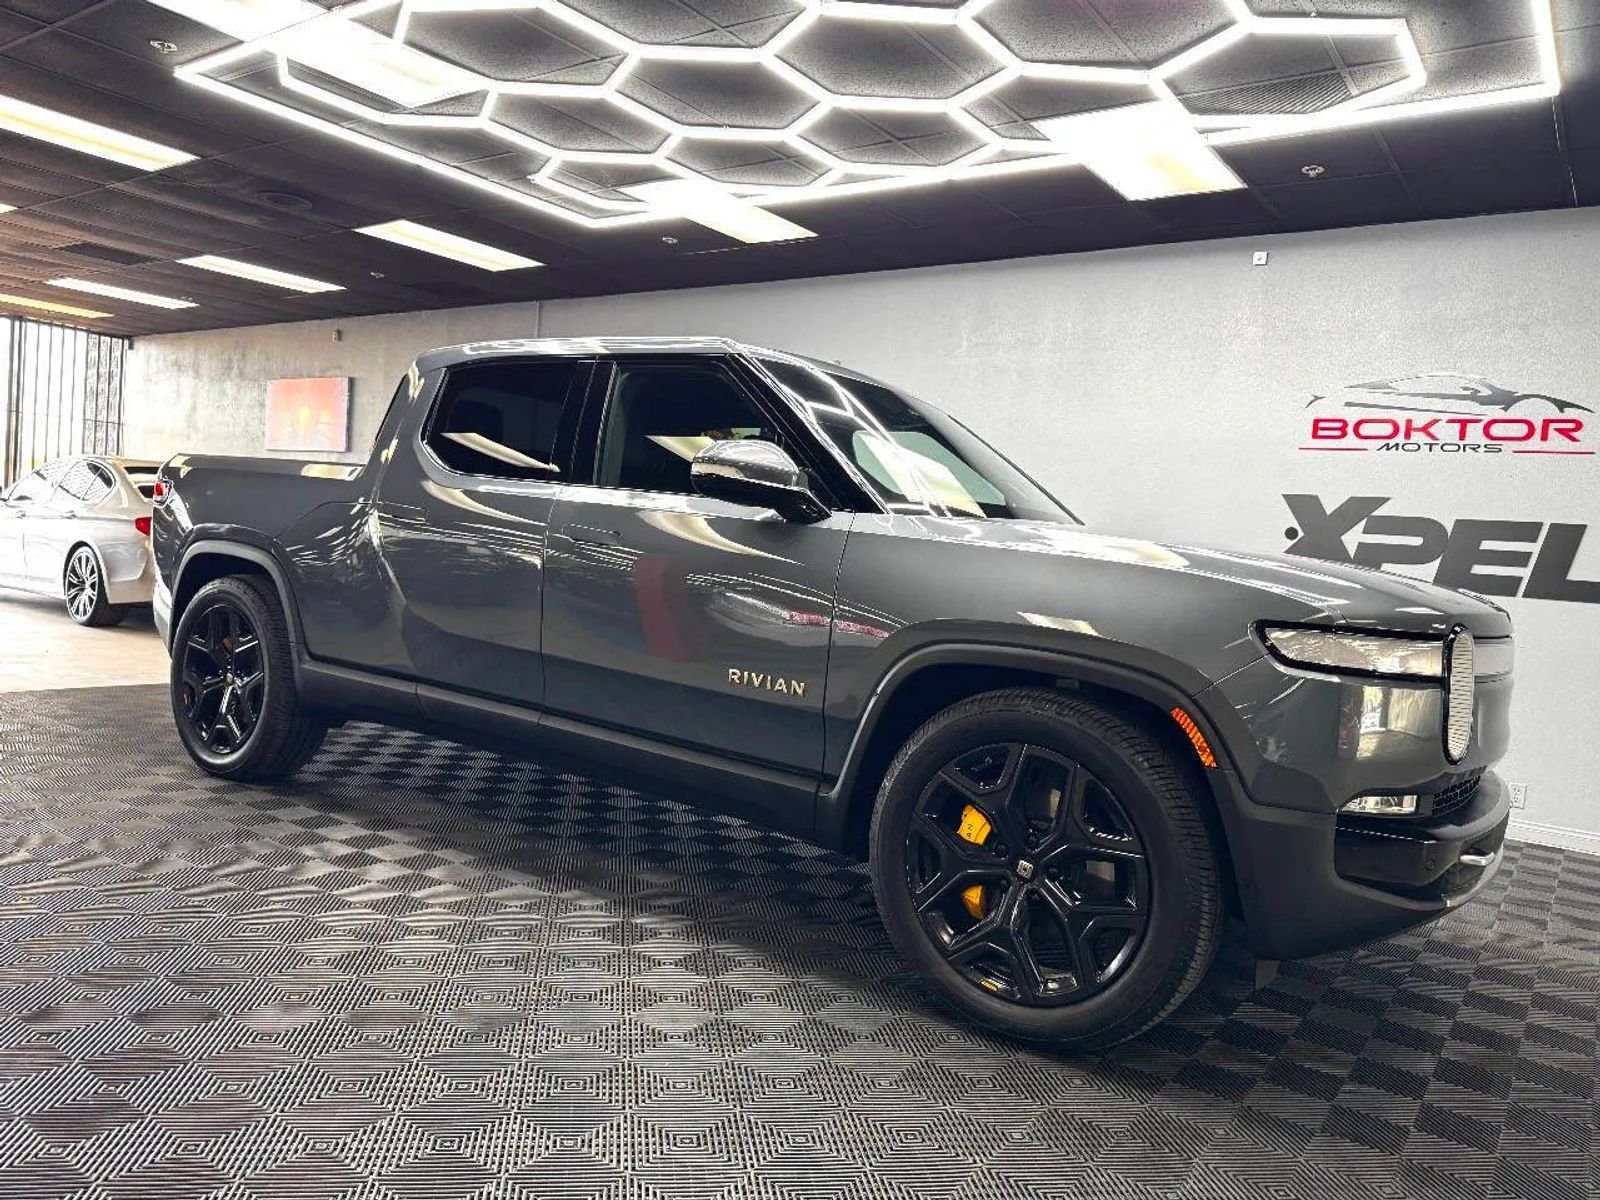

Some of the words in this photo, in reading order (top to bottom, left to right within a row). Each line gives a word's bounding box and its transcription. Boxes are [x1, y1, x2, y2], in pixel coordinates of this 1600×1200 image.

[1311, 417, 1584, 442] BOKTOR
[1376, 442, 1503, 454] MOTORS
[1281, 493, 1600, 604] XPEL
[728, 668, 805, 698] RIVIAN
